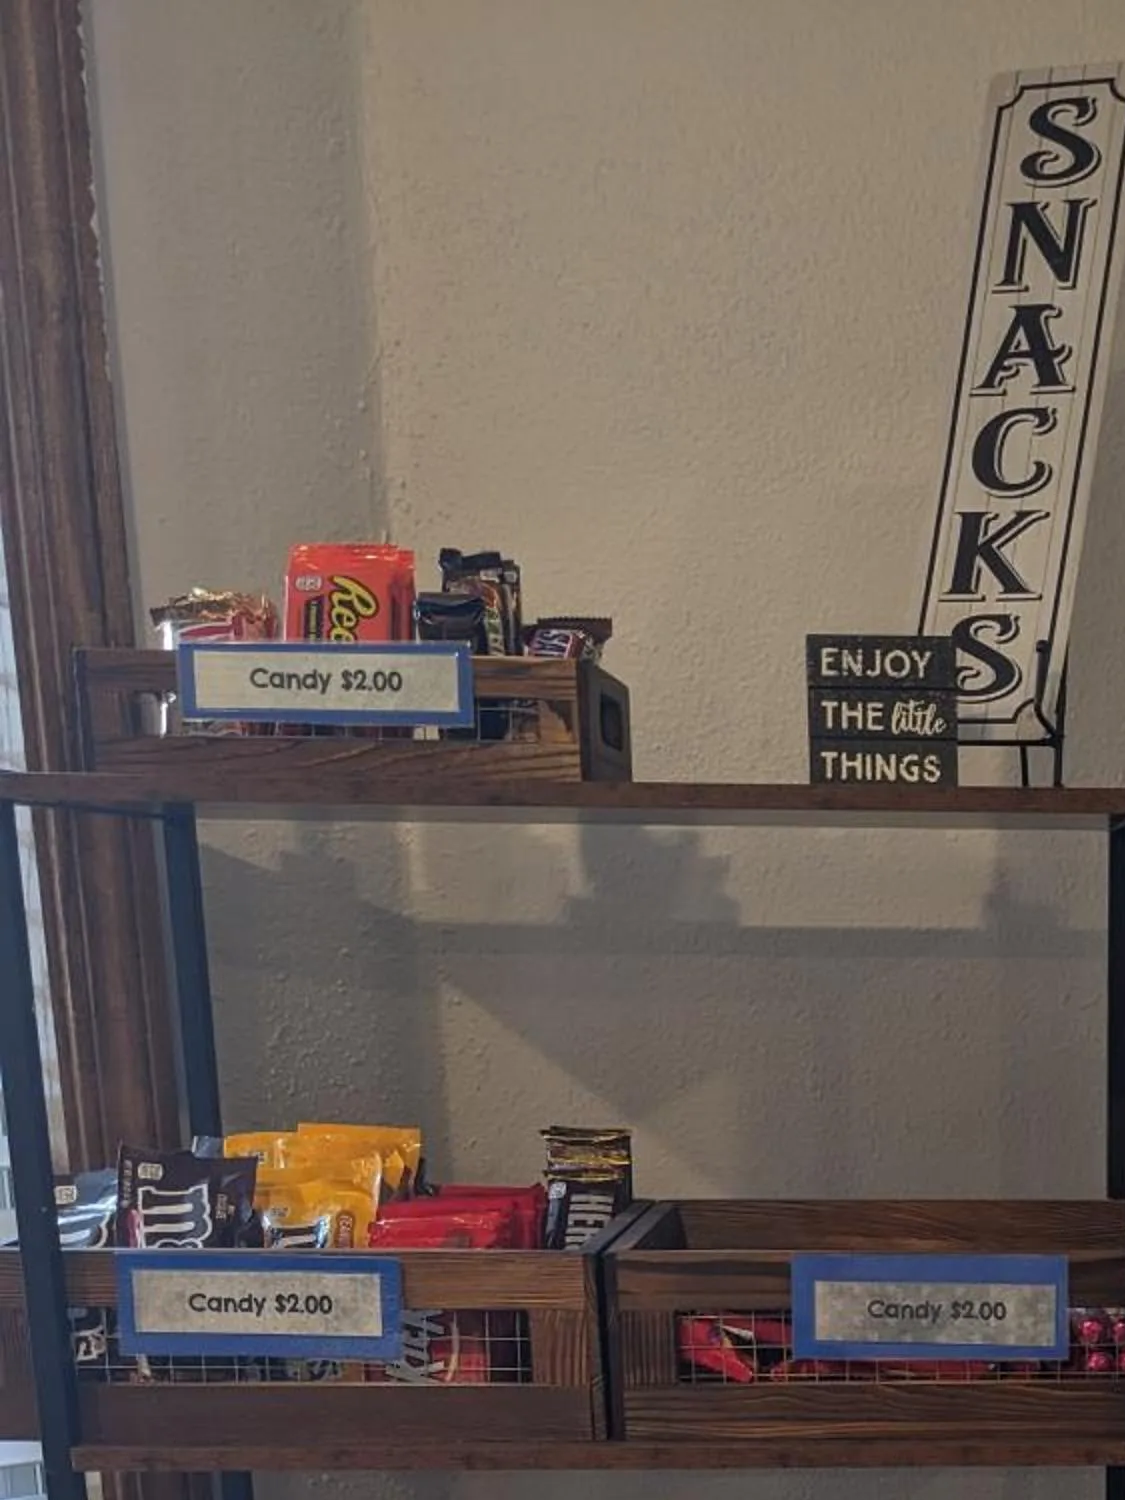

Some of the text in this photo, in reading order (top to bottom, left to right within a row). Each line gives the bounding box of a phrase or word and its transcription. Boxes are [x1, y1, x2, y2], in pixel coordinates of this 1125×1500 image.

[936, 97, 1103, 703] SNACKS
[820, 647, 932, 679] ENJOY
[249, 667, 404, 693] Candy $2.00
[820, 699, 948, 736] THE little
[820, 751, 942, 784] THINGS
[188, 1292, 334, 1318] Candy $2.00
[866, 1299, 1008, 1325] Candy $2.00
